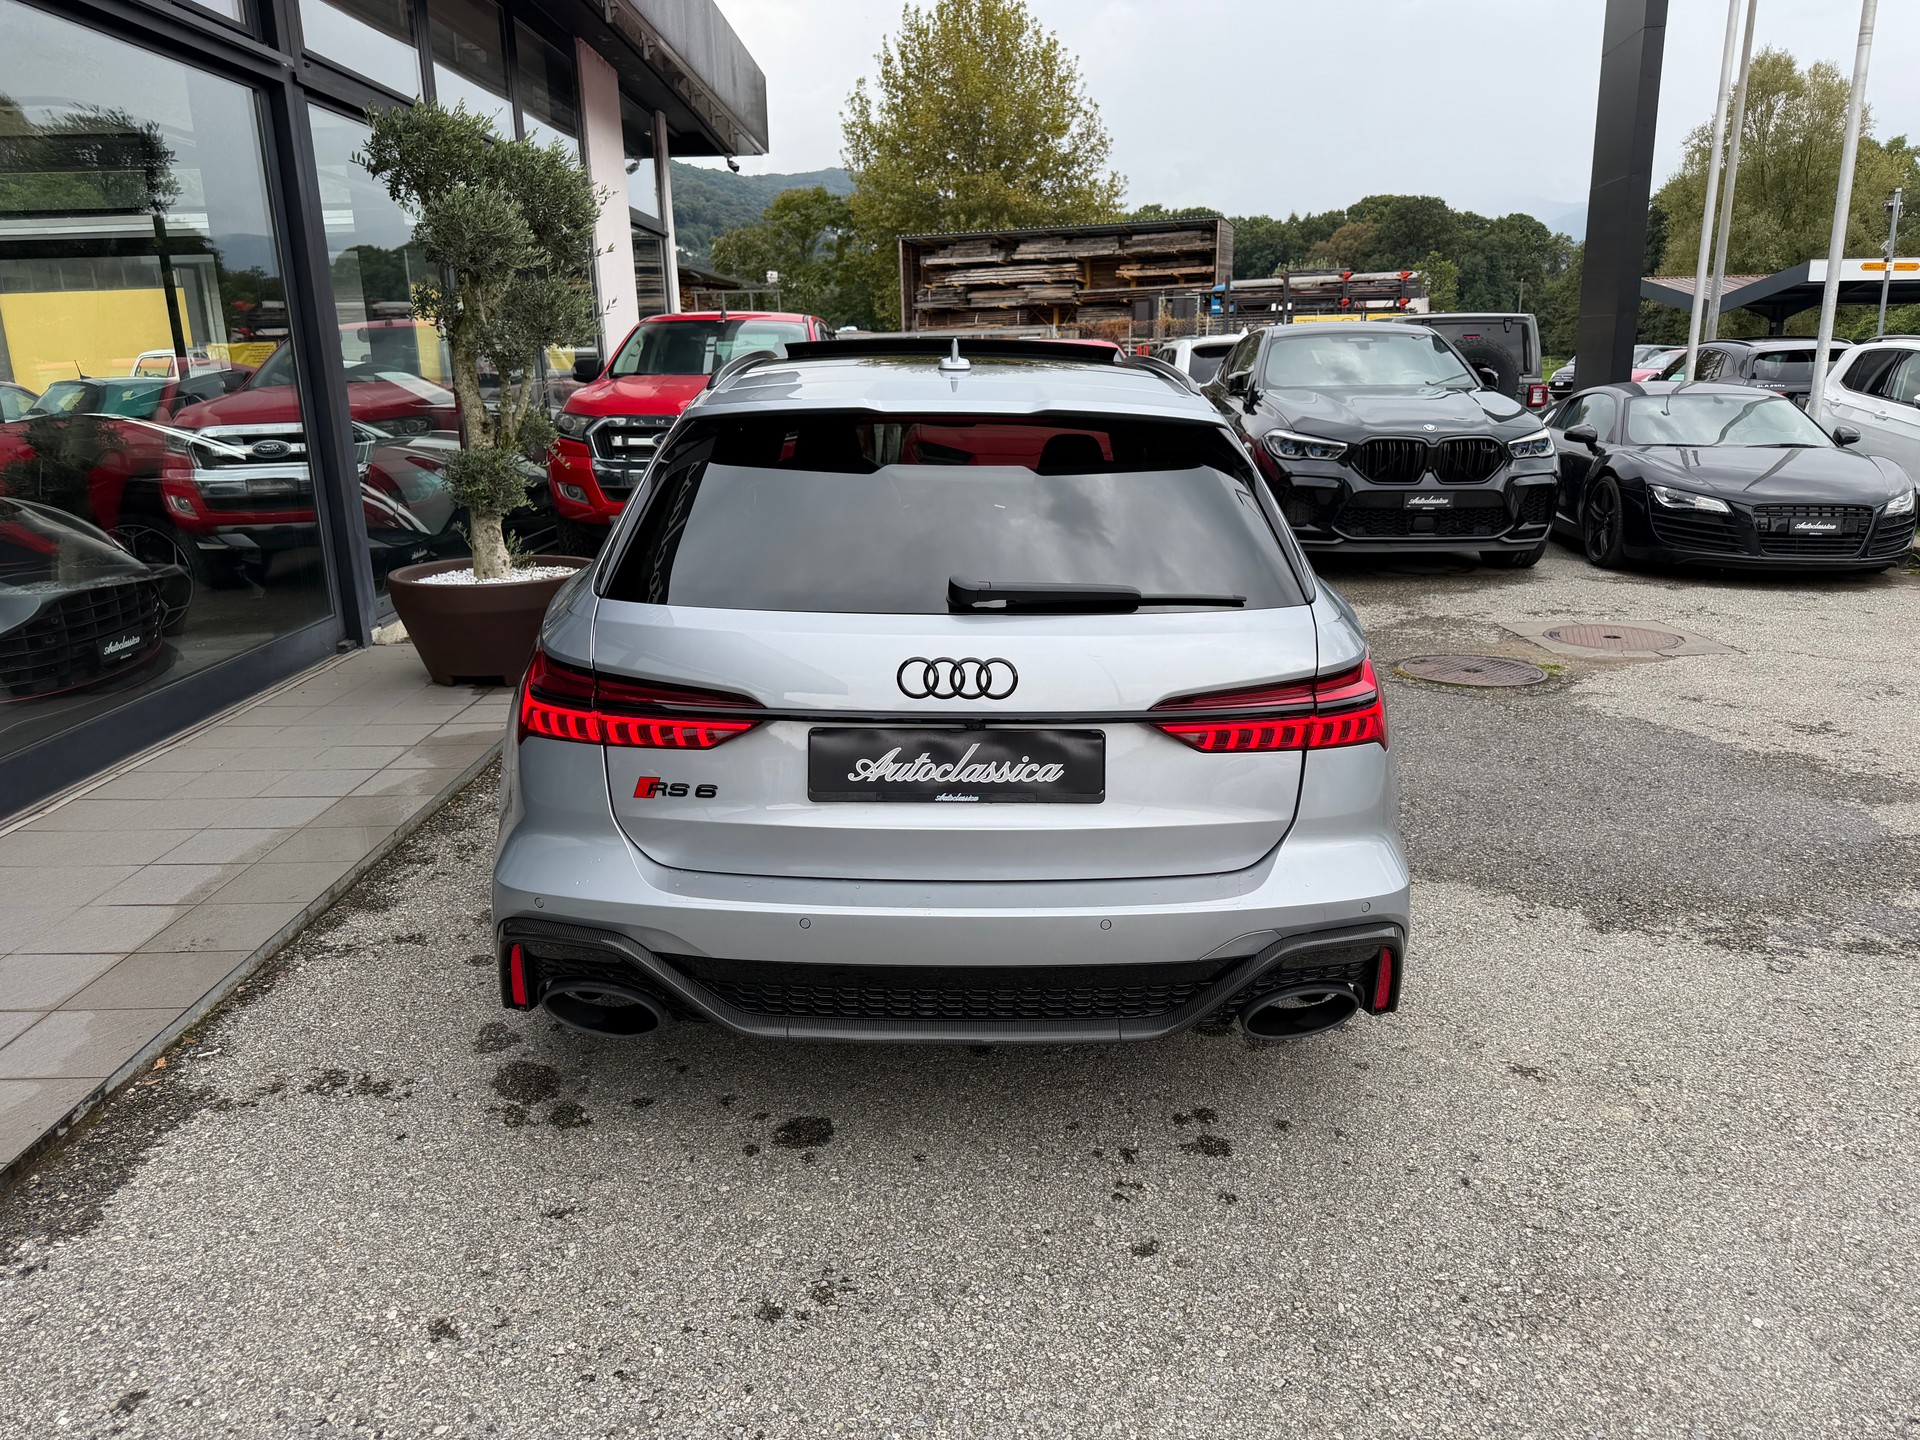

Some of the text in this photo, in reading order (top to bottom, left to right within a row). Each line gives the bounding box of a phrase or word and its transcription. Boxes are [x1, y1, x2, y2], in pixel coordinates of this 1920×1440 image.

[103, 635, 141, 656] Autoclassica
[847, 742, 1065, 784] Autoclassica
[645, 780, 719, 799] RS 6
[934, 792, 980, 802] Autoclassica
